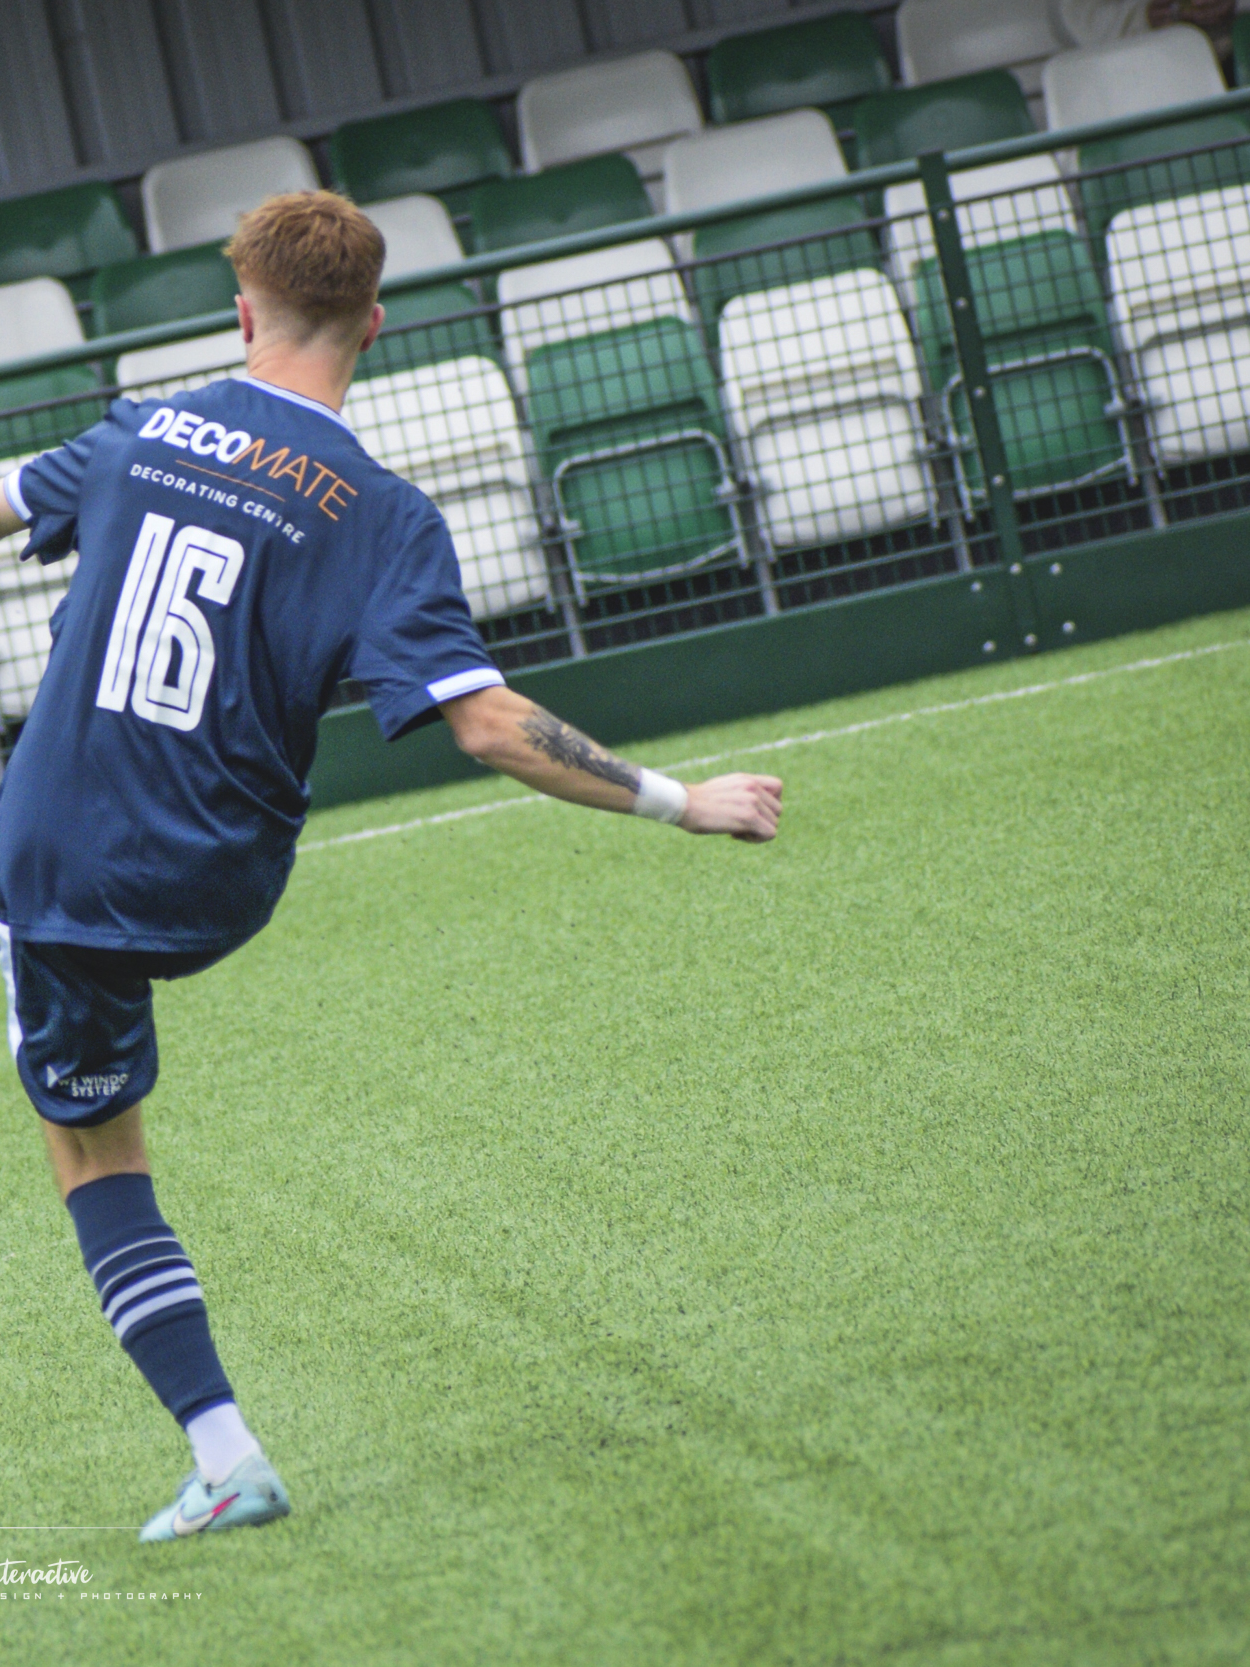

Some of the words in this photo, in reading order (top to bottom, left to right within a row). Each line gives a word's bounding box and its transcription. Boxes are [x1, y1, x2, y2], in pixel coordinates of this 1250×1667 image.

[130, 463, 238, 508] DECORATING
[138, 407, 358, 521] DECOMATE
[95, 511, 245, 732] 16
